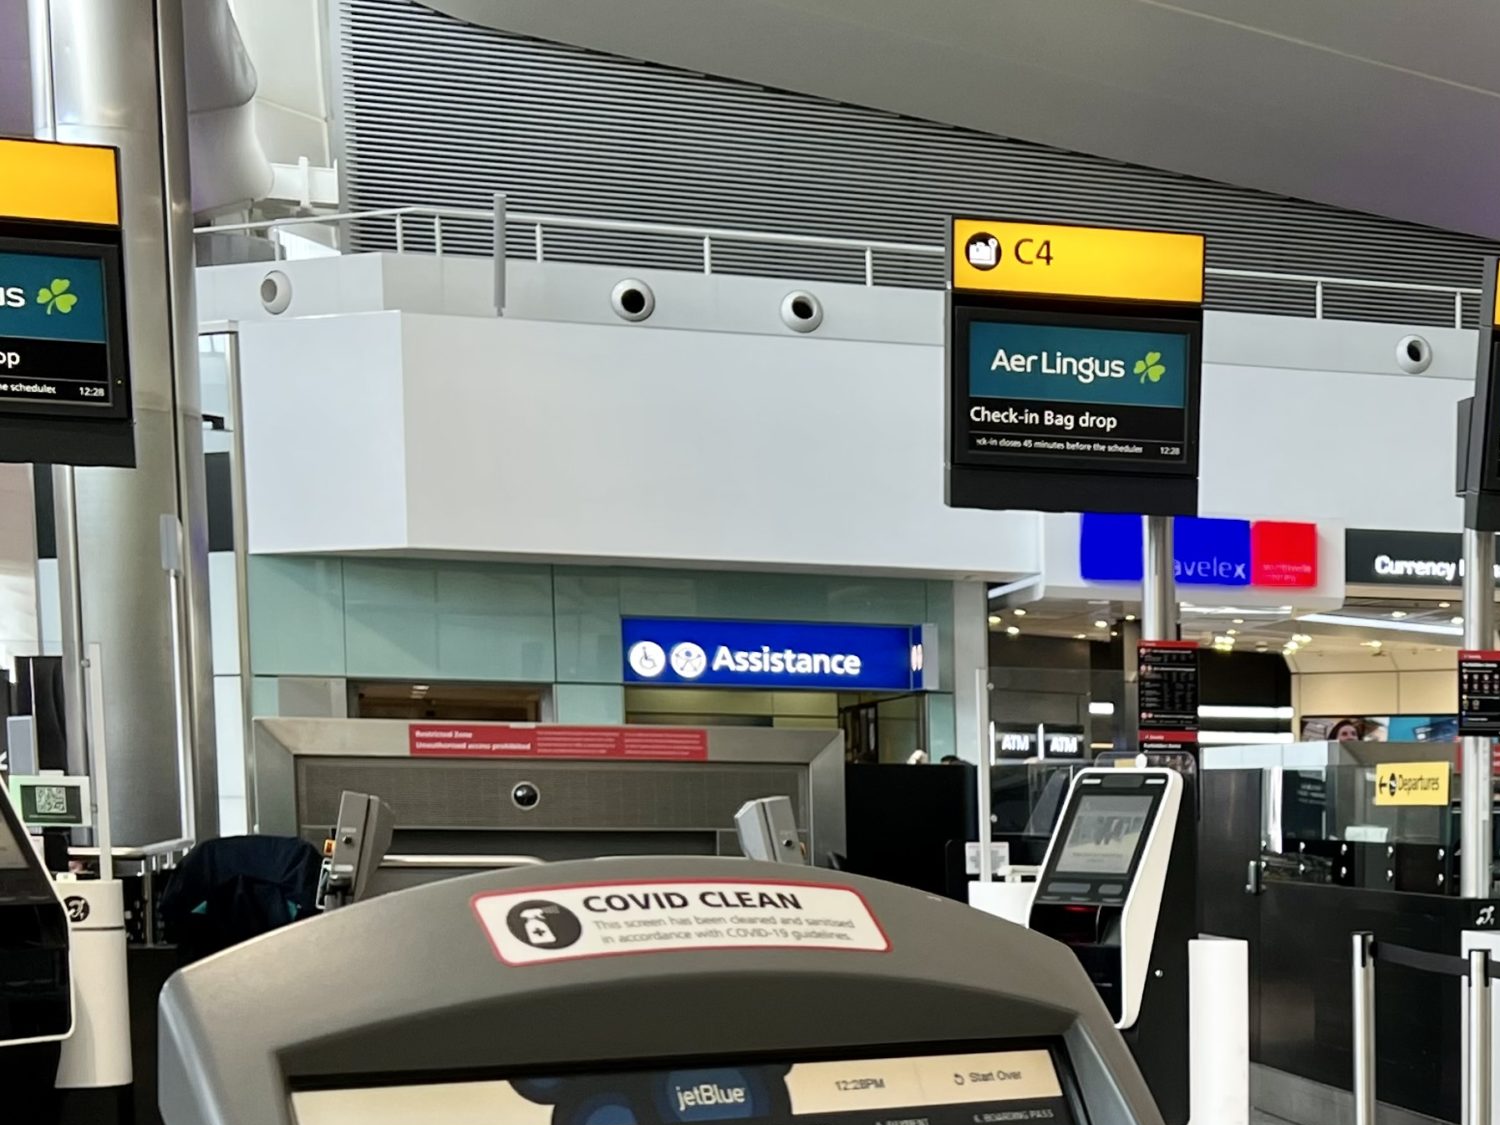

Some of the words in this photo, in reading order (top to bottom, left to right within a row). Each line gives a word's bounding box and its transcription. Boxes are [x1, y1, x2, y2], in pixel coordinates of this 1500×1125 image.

[1014, 239, 1053, 266] C4
[991, 349, 1037, 373] Aer
[1042, 351, 1125, 383] Lingus
[970, 406, 1039, 425] Check-in
[1044, 411, 1075, 430] Bag
[1079, 412, 1118, 432] drop
[1374, 554, 1456, 581] Currency
[713, 646, 861, 675] Assistance
[1001, 735, 1030, 751] ATM
[1050, 736, 1078, 753] ATM
[1398, 774, 1440, 791] Departures
[582, 891, 689, 913] COVID
[699, 891, 803, 910] CLEAN
[593, 920, 621, 931] This
[624, 918, 667, 928] screen
[668, 915, 692, 925] has
[693, 915, 727, 925] been
[730, 915, 777, 925] cleaned
[780, 916, 803, 925] and
[601, 935, 615, 944] in
[618, 930, 692, 943] accordance
[694, 928, 724, 939] with
[726, 927, 789, 939] COVID-19
[969, 1072, 995, 1083] Start
[997, 1070, 1022, 1081] Over
[675, 1083, 746, 1111] jetBlue
[1030, 1109, 1054, 1119] PASS
